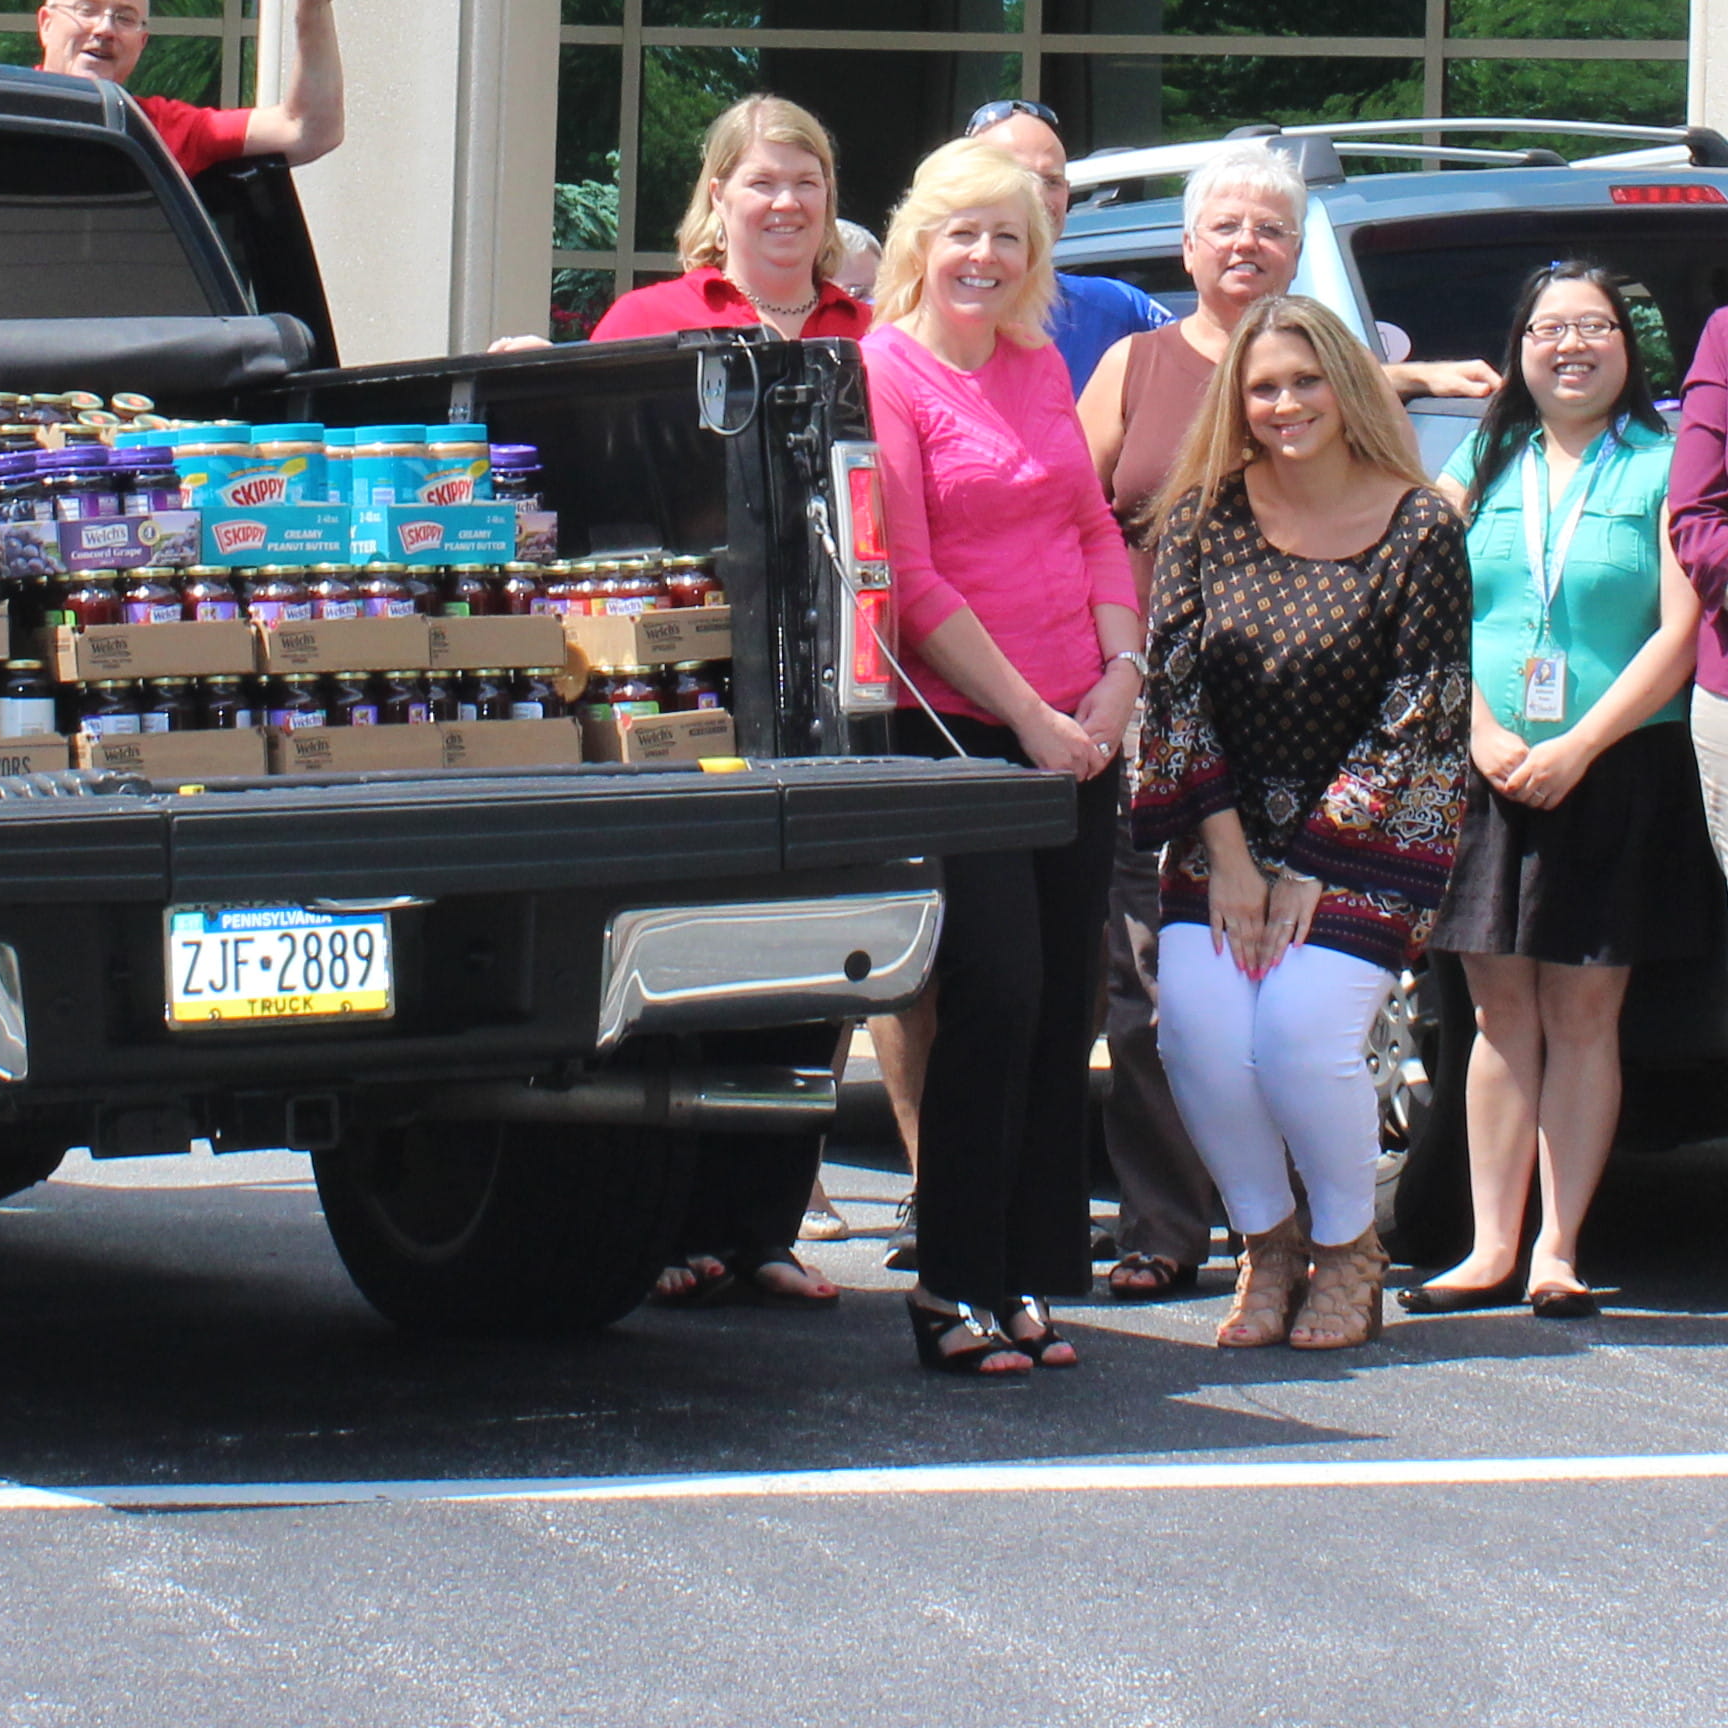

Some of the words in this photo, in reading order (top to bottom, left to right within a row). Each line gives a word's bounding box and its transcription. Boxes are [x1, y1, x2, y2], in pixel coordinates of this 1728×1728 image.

[232, 477, 285, 506] SKIPPY
[427, 479, 472, 506] SKIPPY
[86, 526, 127, 545] Welch's
[223, 525, 265, 547] SKIPPY
[284, 530, 324, 539] CREAMY
[407, 525, 442, 545] SKIPPY
[71, 548, 112, 560] Concord
[113, 547, 143, 558] Grape
[267, 542, 304, 551] PEANUT
[305, 541, 341, 551] BUTTER
[444, 543, 476, 551] PEANUT
[477, 541, 507, 551] BUTTER
[247, 996, 314, 1016] TRUCK
